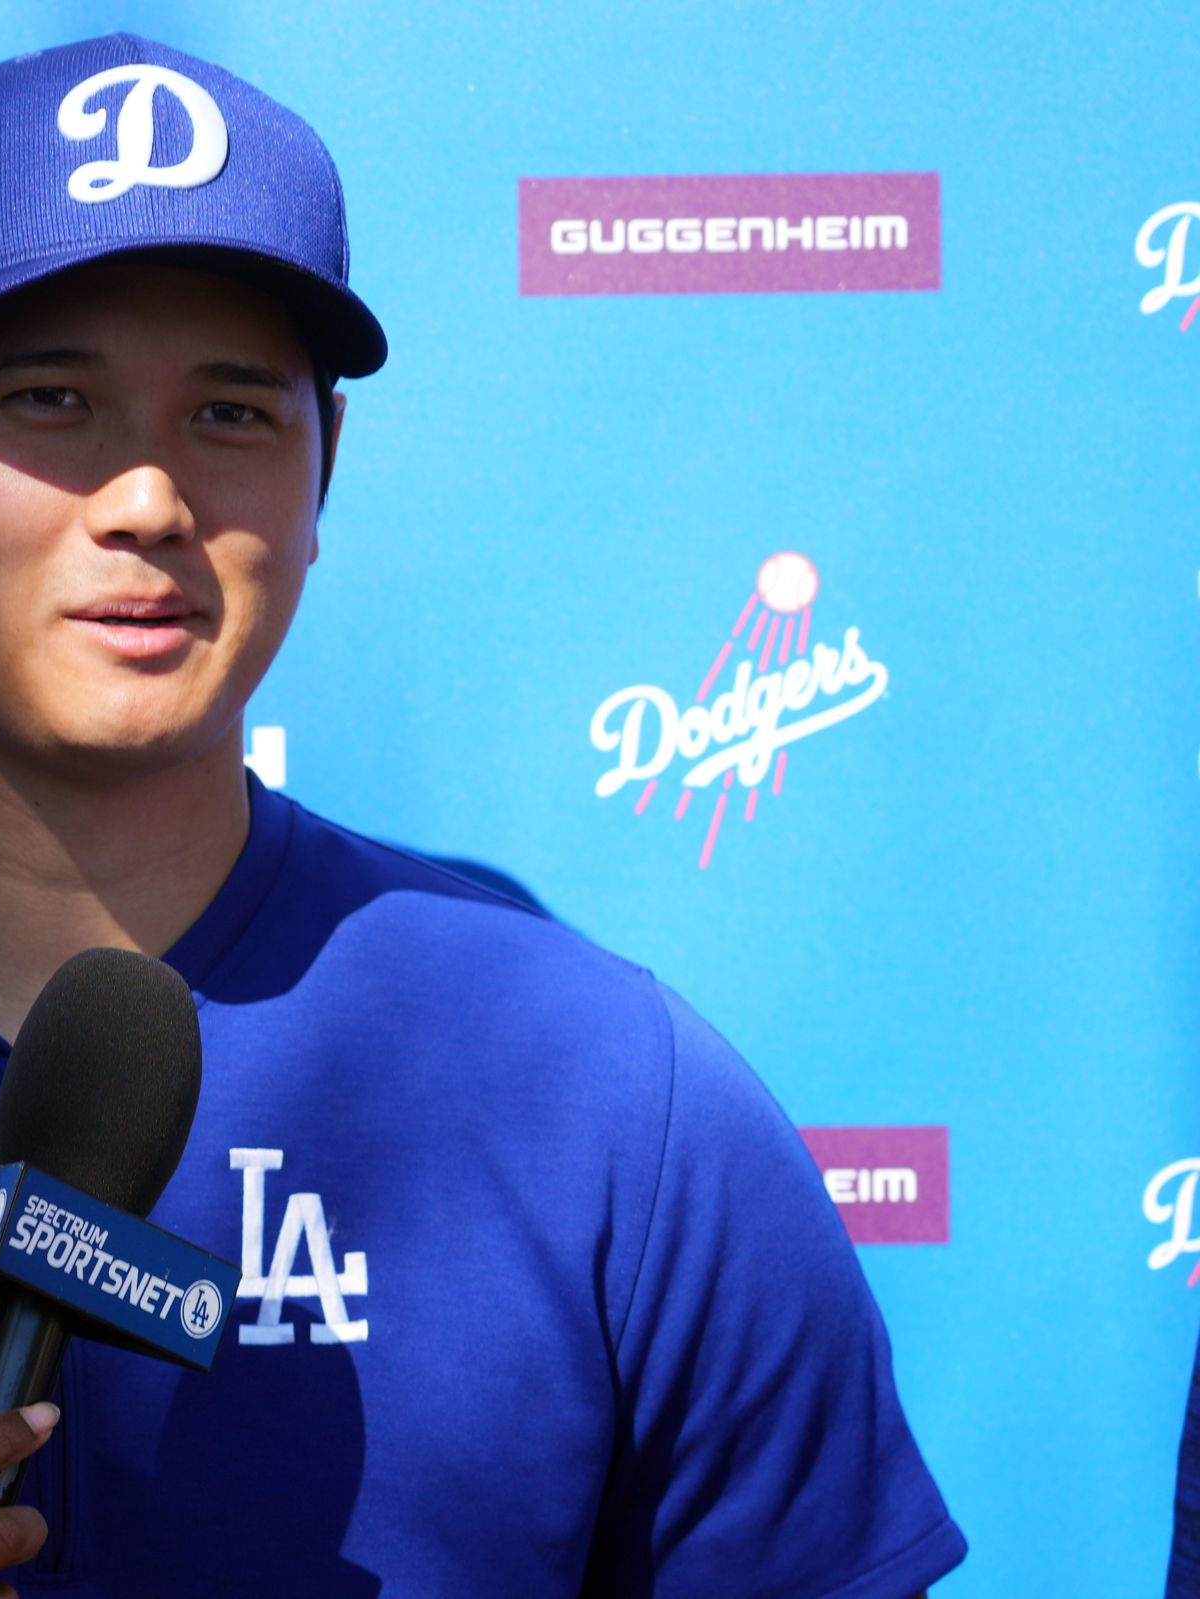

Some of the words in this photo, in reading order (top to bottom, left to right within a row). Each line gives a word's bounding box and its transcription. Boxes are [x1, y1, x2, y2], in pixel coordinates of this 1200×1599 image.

[56, 63, 228, 205] D
[551, 216, 908, 253] GUGGENHEIM
[590, 627, 887, 797] Dodgers
[8, 1214, 185, 1320] SPORTSNET
[24, 1195, 108, 1249] SPECTRUM
[229, 1147, 369, 1345] LA
[191, 1288, 209, 1329] LA
